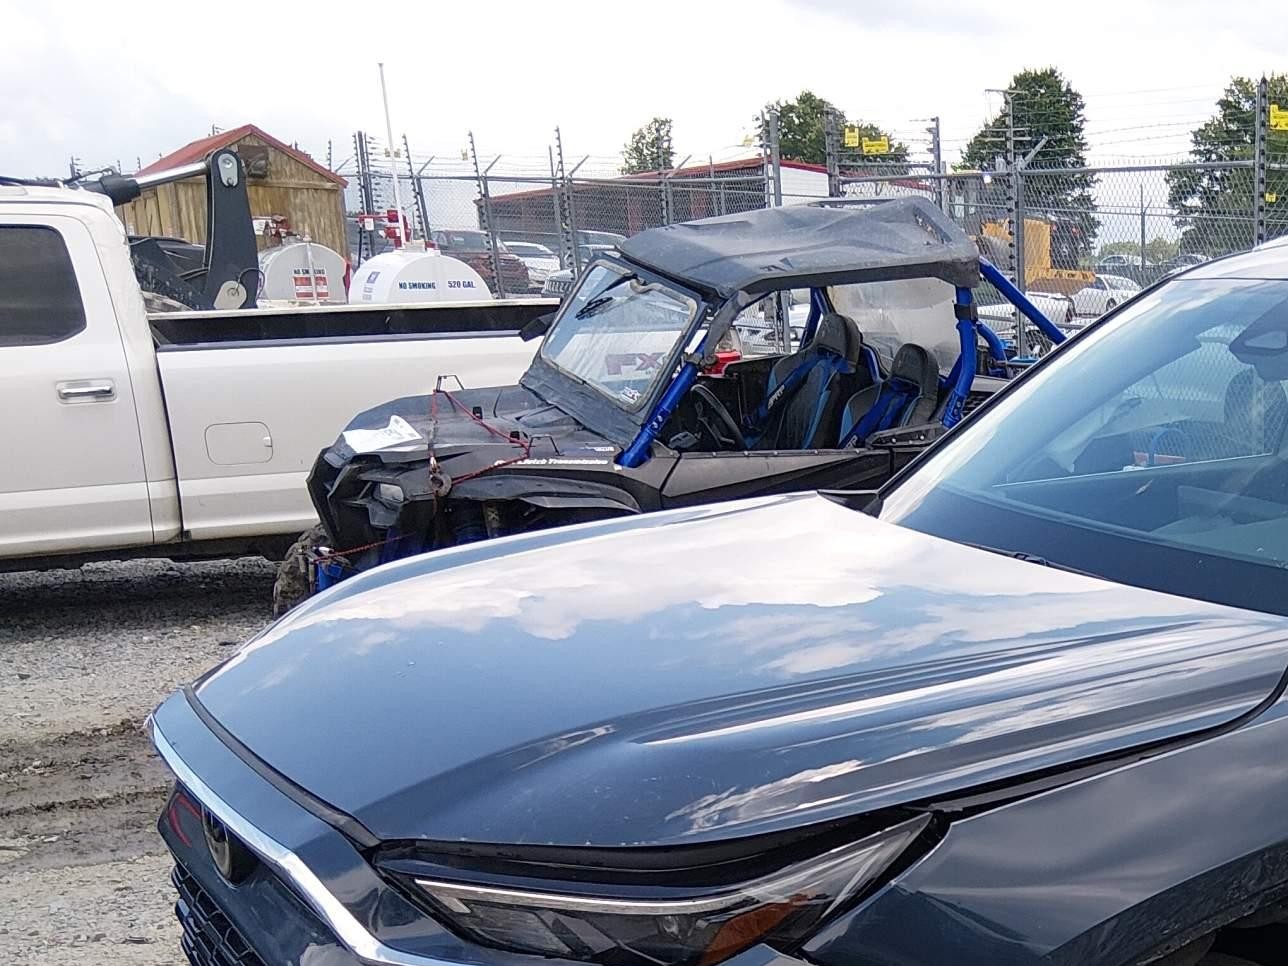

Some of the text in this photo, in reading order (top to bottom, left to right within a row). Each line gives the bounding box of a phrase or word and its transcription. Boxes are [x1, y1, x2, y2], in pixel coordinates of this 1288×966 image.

[398, 282, 436, 290] NO SMOKING
[447, 280, 461, 289] 520
